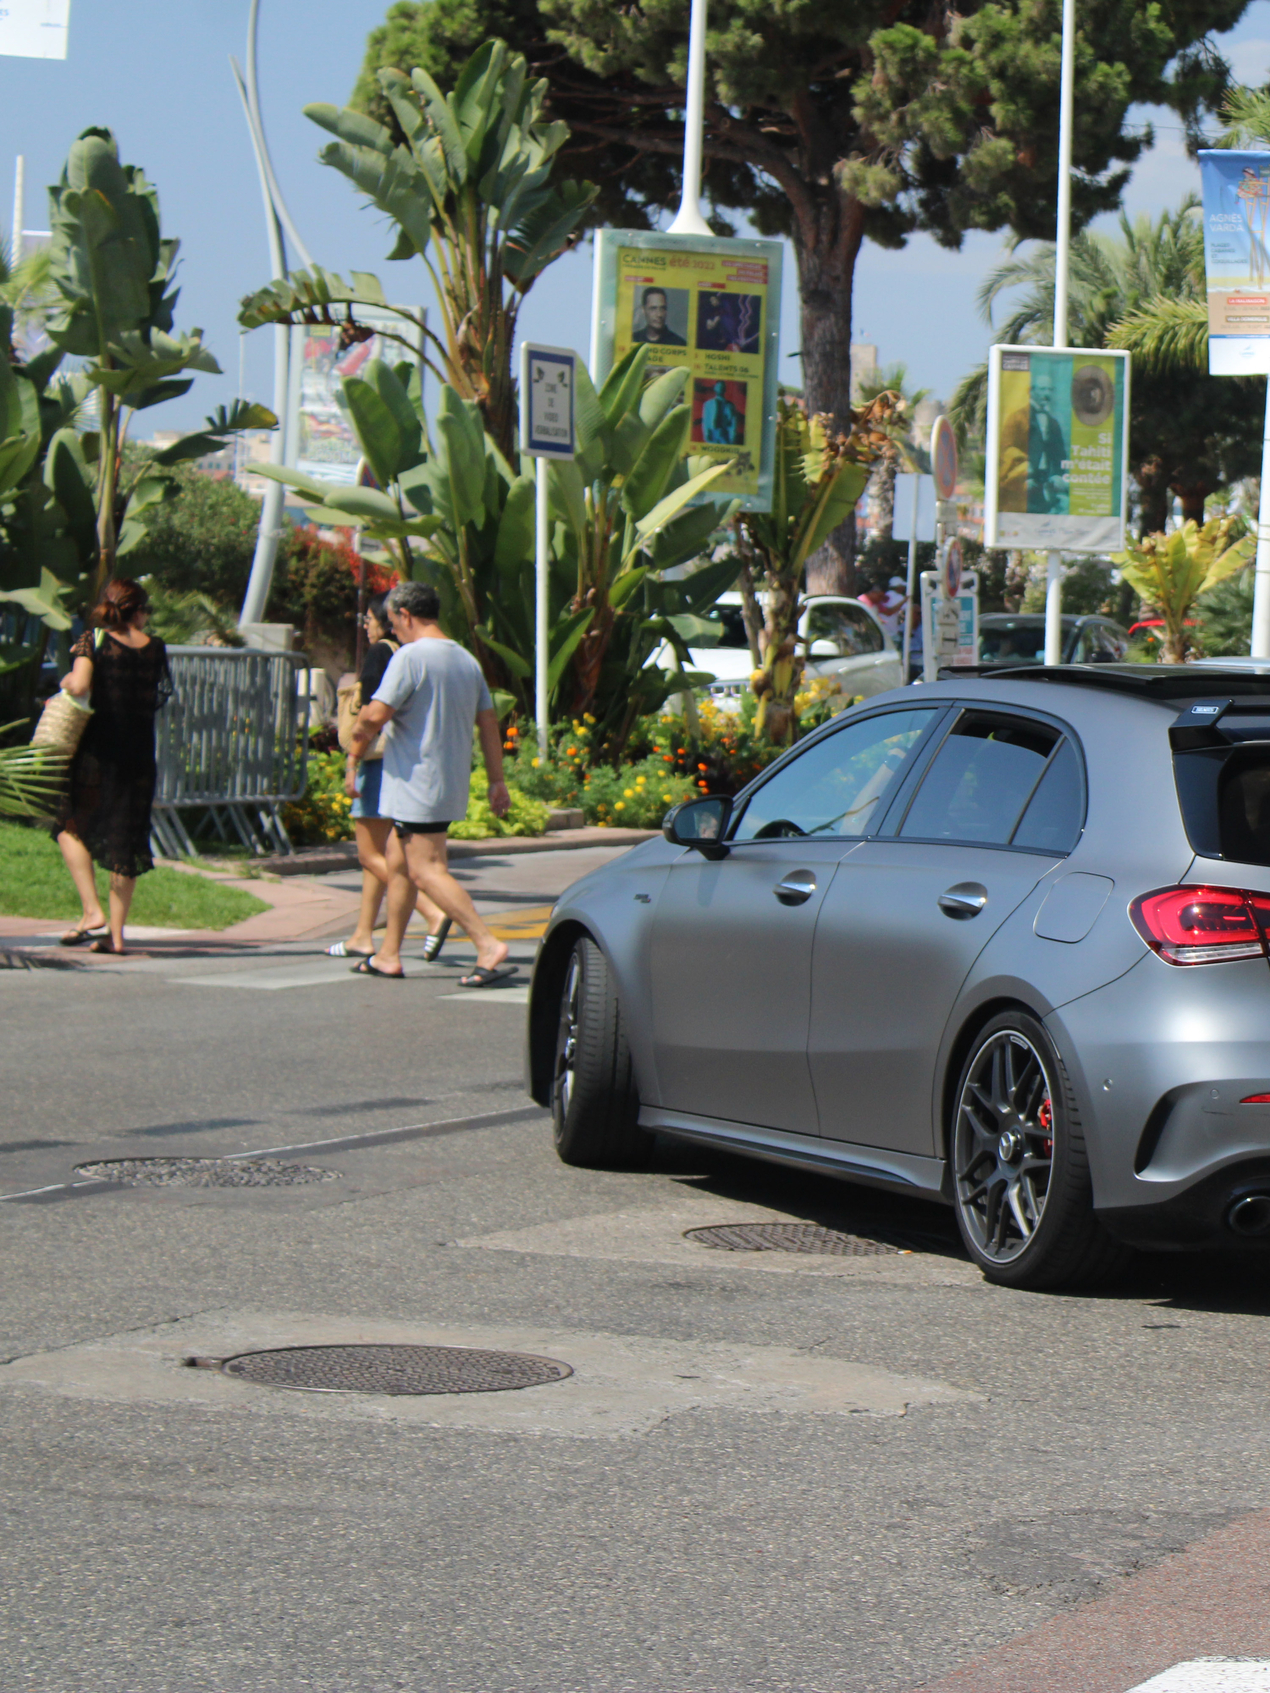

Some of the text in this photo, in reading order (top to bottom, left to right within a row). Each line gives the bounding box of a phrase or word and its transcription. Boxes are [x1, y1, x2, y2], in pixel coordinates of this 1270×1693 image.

[1209, 212, 1243, 223] AGNÈS
[1209, 224, 1245, 232] VARDA
[622, 254, 667, 266] CANNES
[669, 254, 690, 268] été
[659, 347, 687, 356] CORPS
[705, 352, 731, 361] HOSHI
[704, 363, 737, 373] TALENTS
[1097, 432, 1112, 445] Si
[1070, 444, 1112, 458] Tahiti
[1061, 473, 1111, 485] contée
